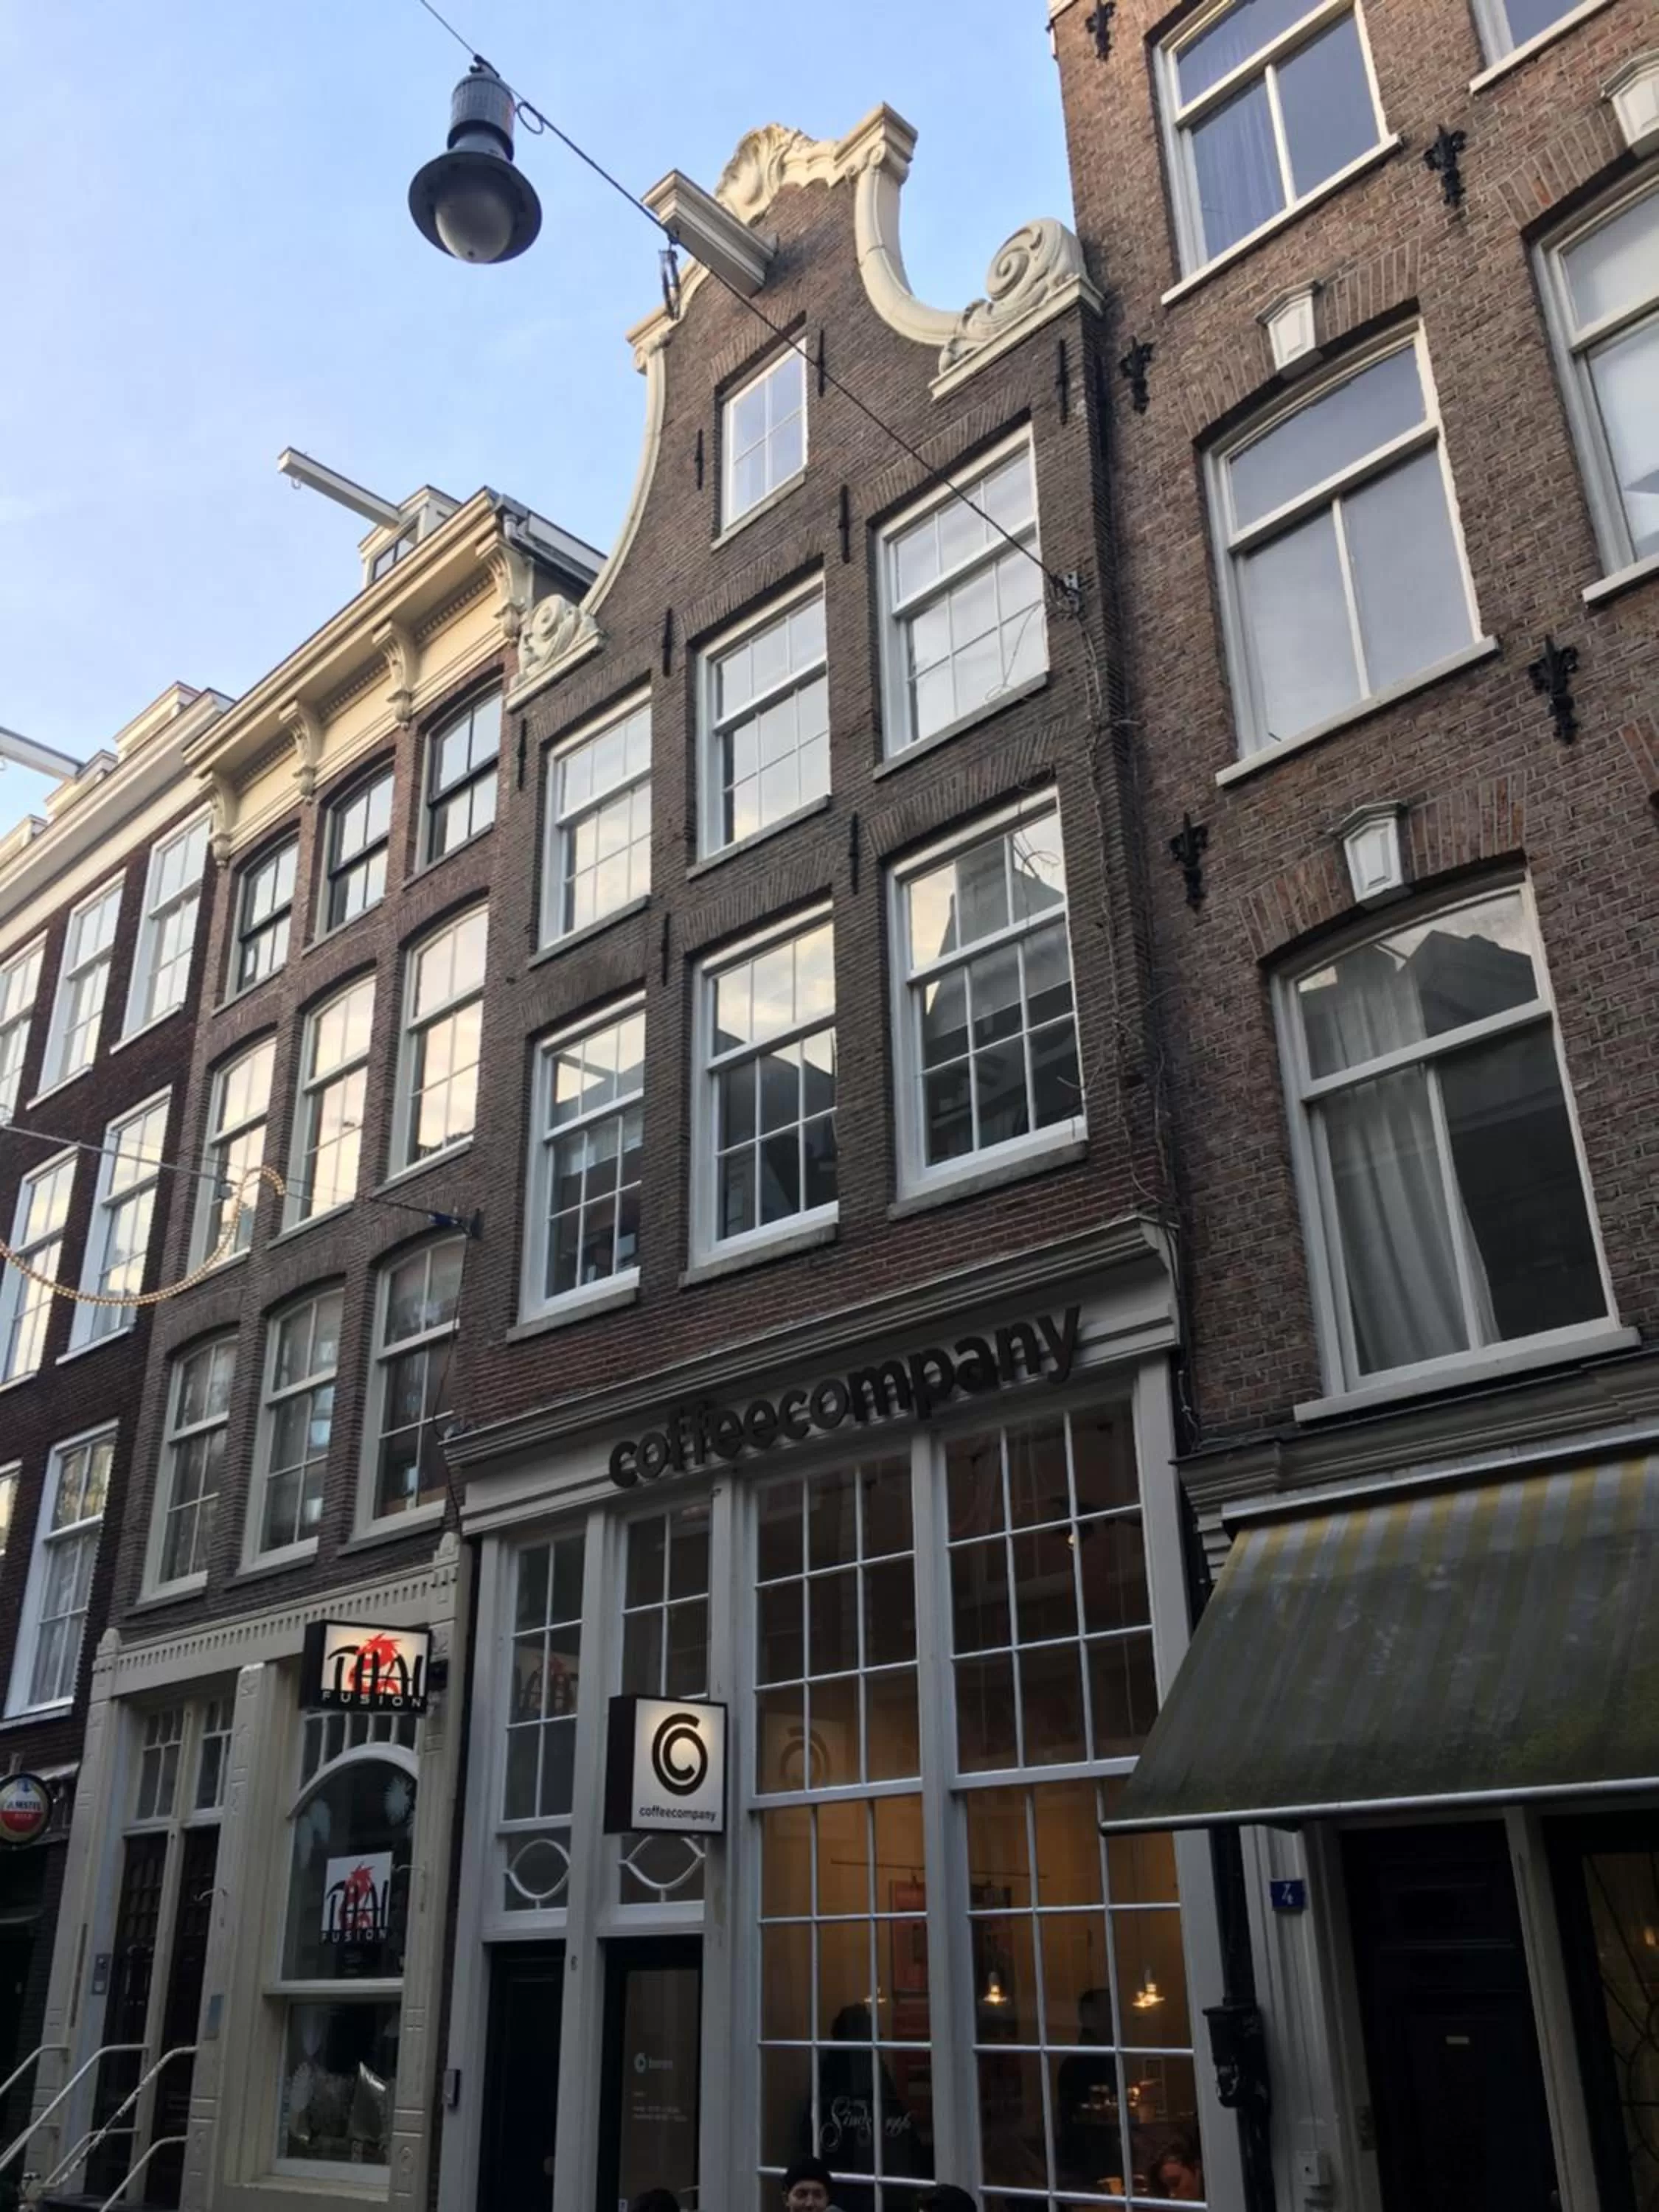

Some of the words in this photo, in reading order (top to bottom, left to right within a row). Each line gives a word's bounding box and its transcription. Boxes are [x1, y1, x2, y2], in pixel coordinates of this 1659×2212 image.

[609, 1304, 1081, 1488] coffeecompany
[327, 1645, 423, 1697] THAI
[321, 1691, 422, 1708] FUSION
[639, 1805, 717, 1823] coffeecompany
[326, 1879, 389, 1931] THAI
[321, 1929, 388, 1943] FUSION
